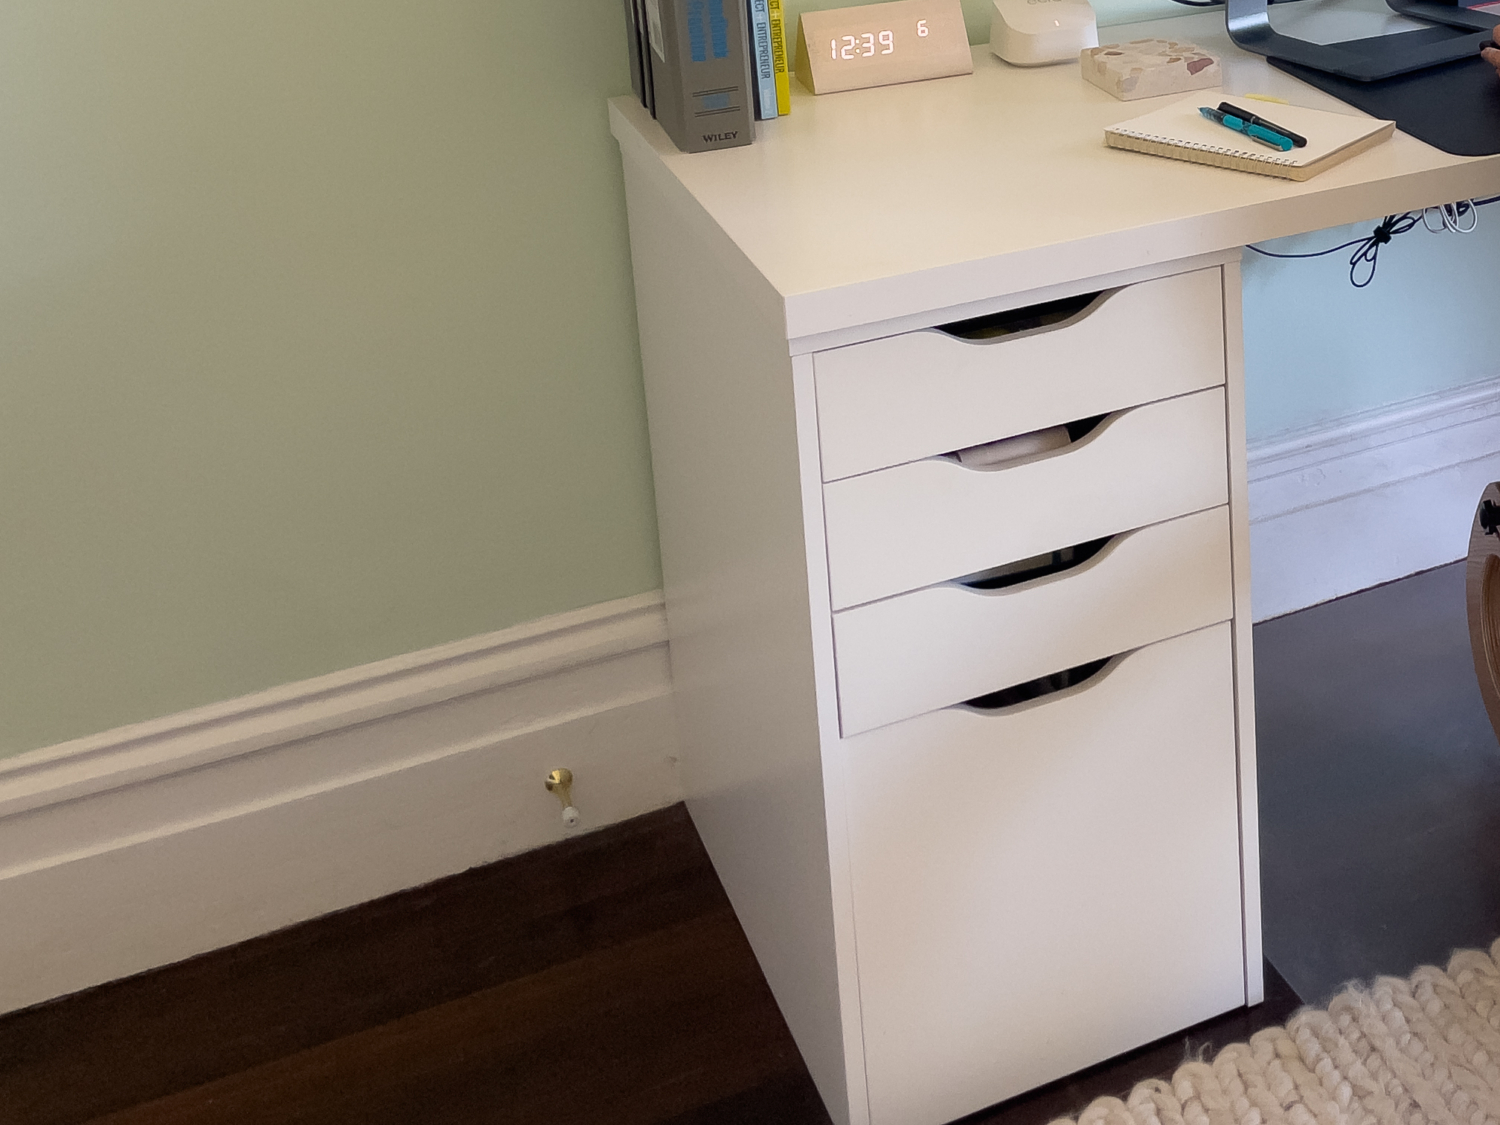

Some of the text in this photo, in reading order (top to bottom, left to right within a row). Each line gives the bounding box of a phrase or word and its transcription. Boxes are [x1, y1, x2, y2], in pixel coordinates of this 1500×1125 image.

[756, 22, 771, 80] ENTREPRENEUR
[771, 19, 785, 74] ENTREPRENEUR
[831, 20, 929, 60] 12:39 6
[702, 131, 738, 143] WILEY
